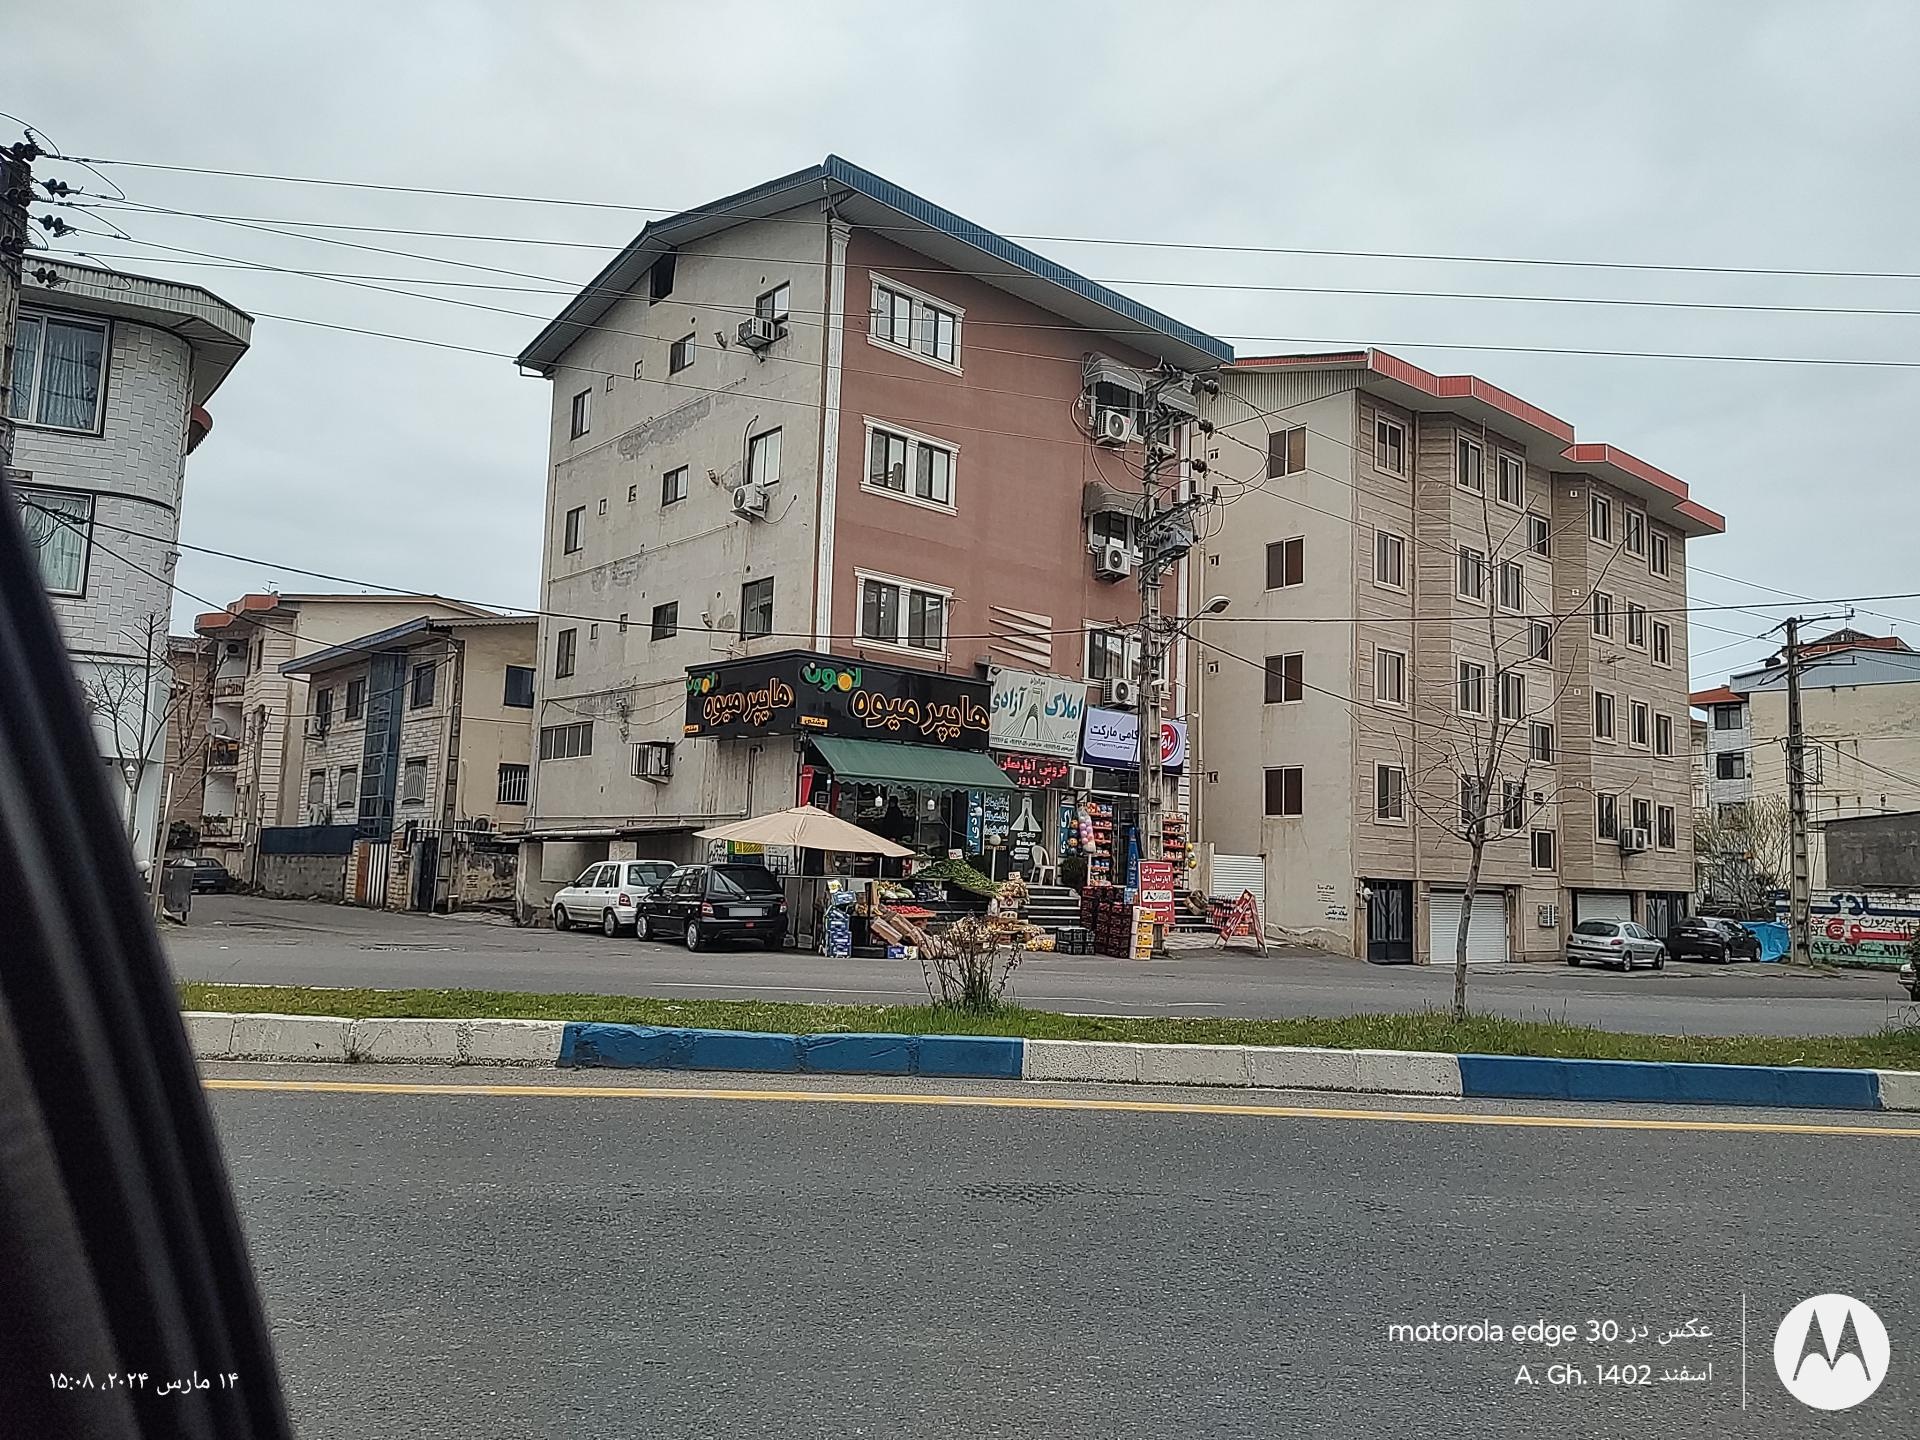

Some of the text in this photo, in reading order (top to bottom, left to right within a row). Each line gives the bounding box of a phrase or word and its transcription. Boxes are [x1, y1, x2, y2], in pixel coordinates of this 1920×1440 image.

[703, 677, 793, 726] هایپر میوه
[990, 687, 1084, 720] املاک آزادی
[852, 690, 991, 742] هایپر میوه
[1090, 724, 1117, 739] مارکت
[1142, 865, 1171, 874] فروش
[1151, 875, 1171, 883] آپارتمان
